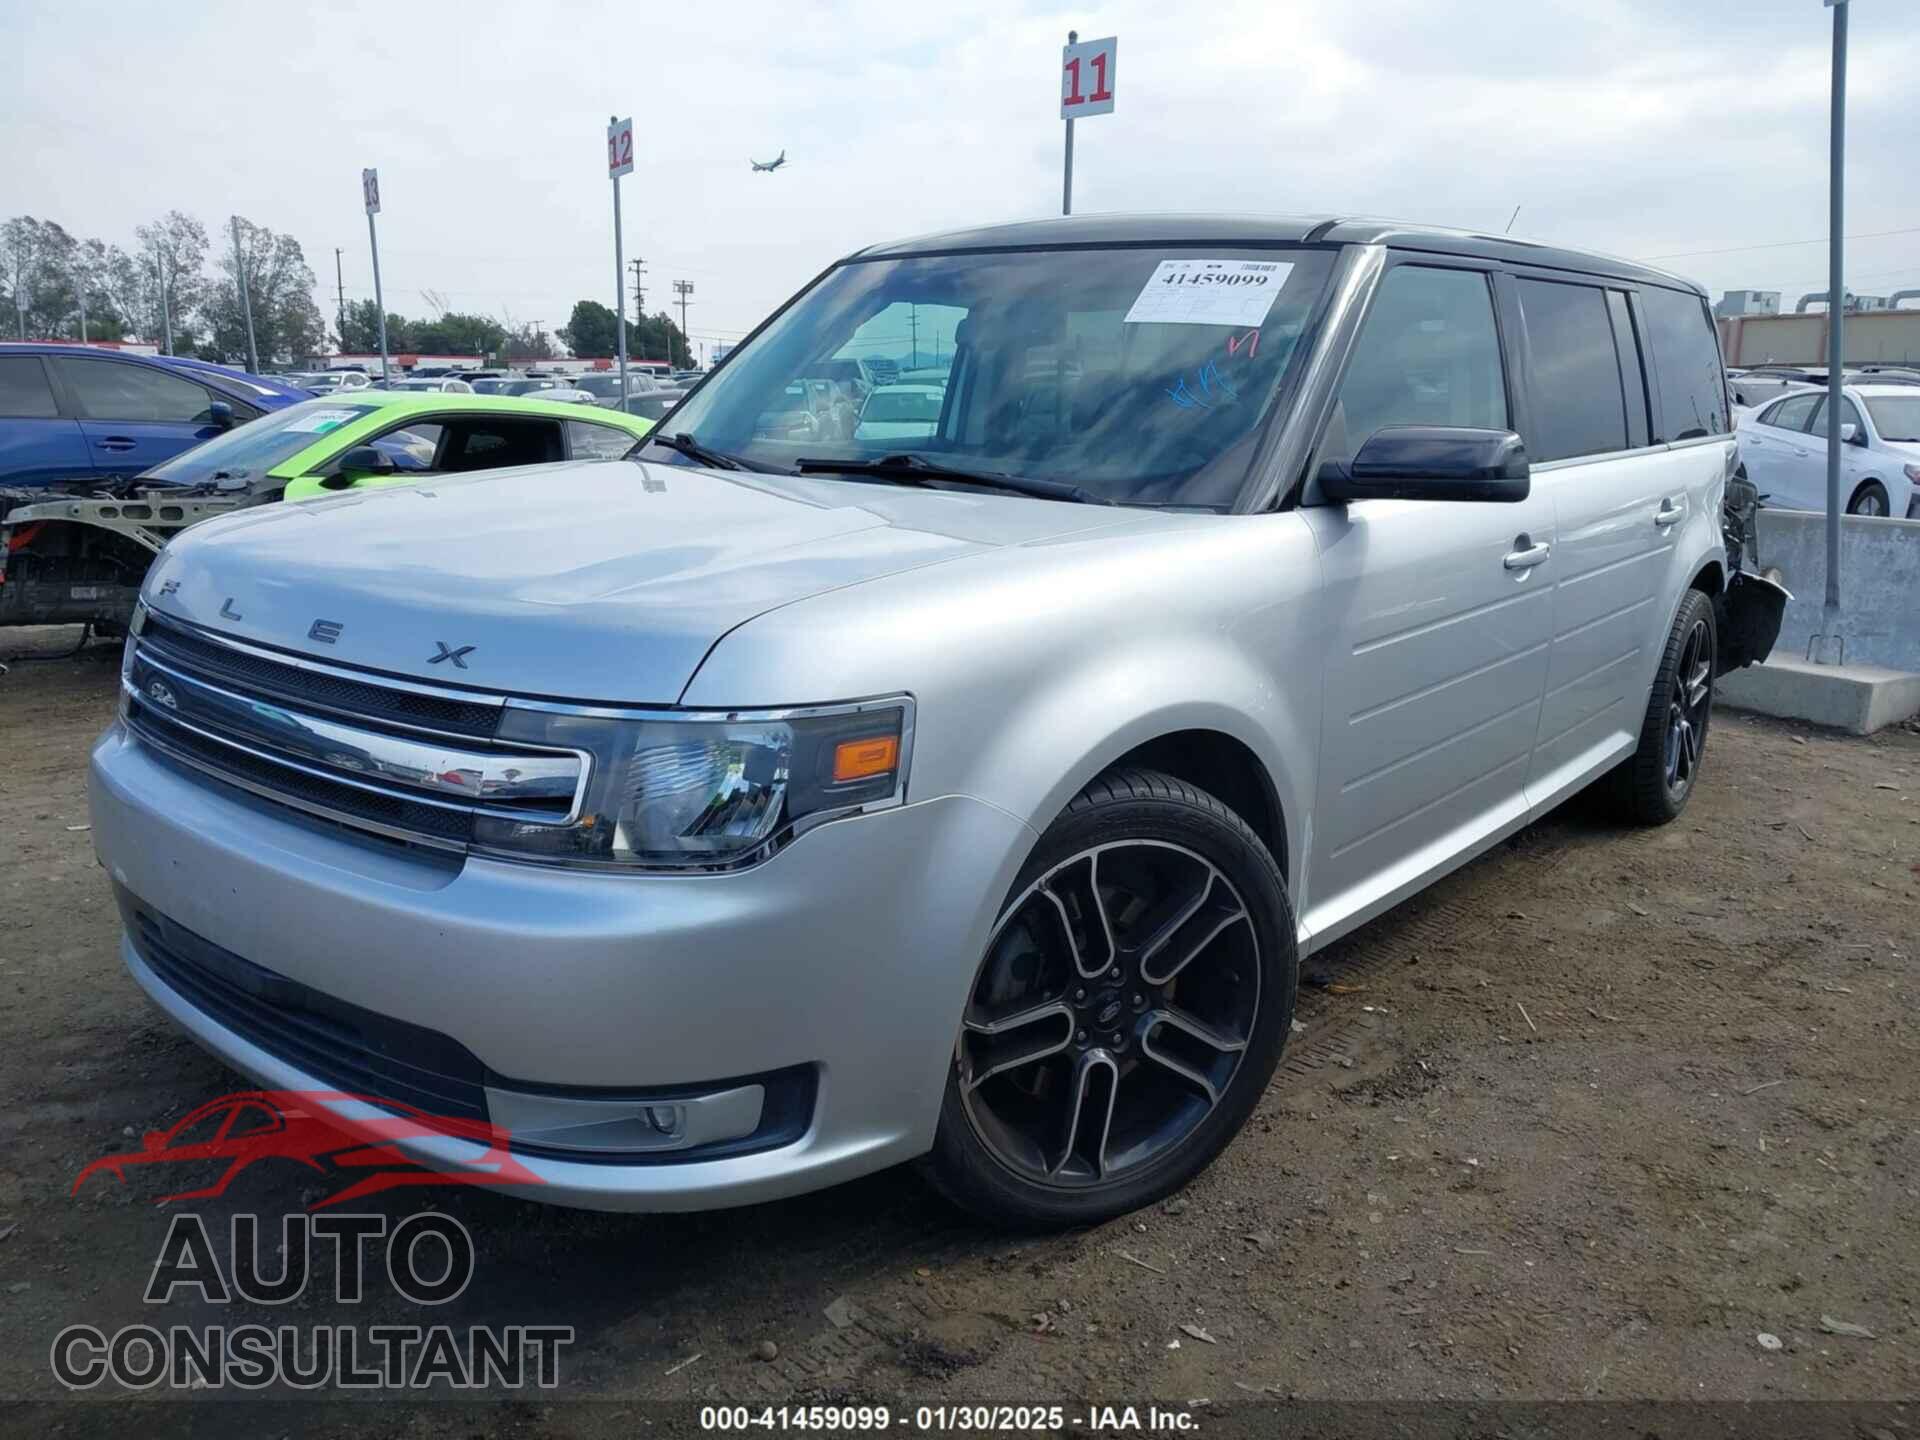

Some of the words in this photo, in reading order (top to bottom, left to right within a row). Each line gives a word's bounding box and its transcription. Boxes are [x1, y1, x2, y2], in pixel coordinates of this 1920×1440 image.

[1063, 52, 1111, 105] 11
[608, 130, 632, 169] 12
[1162, 273, 1268, 285] 41459099
